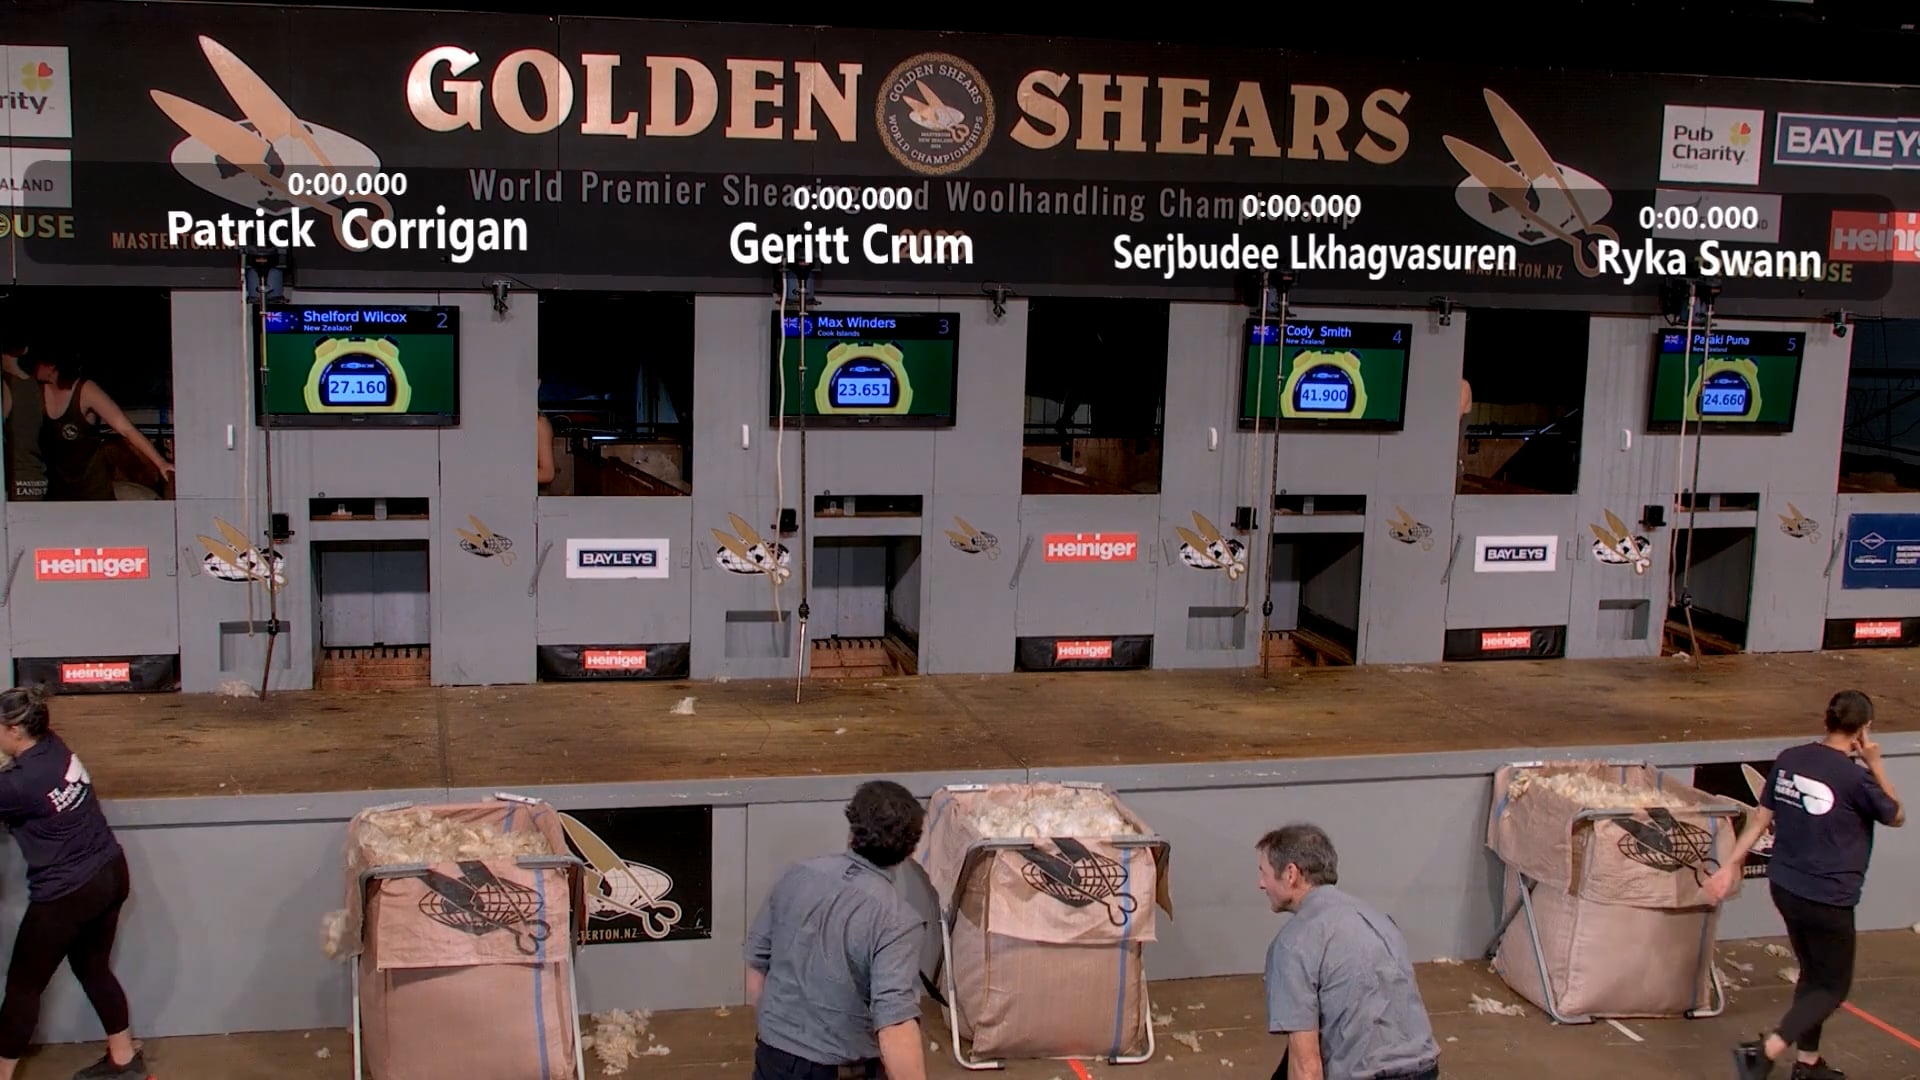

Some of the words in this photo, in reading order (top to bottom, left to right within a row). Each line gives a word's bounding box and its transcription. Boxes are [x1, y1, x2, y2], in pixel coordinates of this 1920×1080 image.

[889, 64, 934, 102] GOLDEN
[938, 64, 983, 105] SHEARS
[405, 45, 863, 142] GOLDEN
[1009, 69, 1412, 165] SHEARS
[889, 114, 911, 152] WORLD
[910, 115, 984, 165] CHAMPIONSHIPS
[1673, 124, 1713, 142] Pub
[1672, 143, 1746, 166] Charity
[469, 168, 562, 202] World
[581, 170, 707, 205] Premier
[722, 174, 863, 215] Sheaig
[945, 180, 1146, 223] Woolhandling
[303, 311, 360, 323] Shelford
[363, 312, 408, 324] Wilcox
[436, 313, 449, 329] 2
[818, 317, 844, 328] Max
[847, 317, 897, 329] Winders
[938, 319, 950, 335] 3
[1286, 325, 1315, 339] Cody
[1320, 325, 1352, 338] Smith
[1300, 338, 1326, 346] Zealand
[1392, 329, 1403, 345] 4
[1694, 334, 1724, 346] Paaki
[1726, 335, 1750, 346] Puna
[1787, 337, 1797, 351] 5
[329, 380, 387, 395] 27.160
[838, 383, 890, 397] 23.651
[1301, 388, 1348, 402] 41.900
[1704, 393, 1745, 406] 24.660
[1048, 533, 1136, 560] Heiniger
[583, 552, 653, 565] BAYLEYS
[1487, 549, 1544, 560] BAYLEYS
[40, 548, 147, 577] Heiniger
[1857, 622, 1900, 637] Heiniger
[1482, 632, 1529, 647] Heiniger
[1058, 641, 1111, 658] Heiniger
[587, 650, 645, 667] Heiniger
[65, 663, 130, 680] Heiniger
[577, 928, 638, 942] TERTON.NZ
